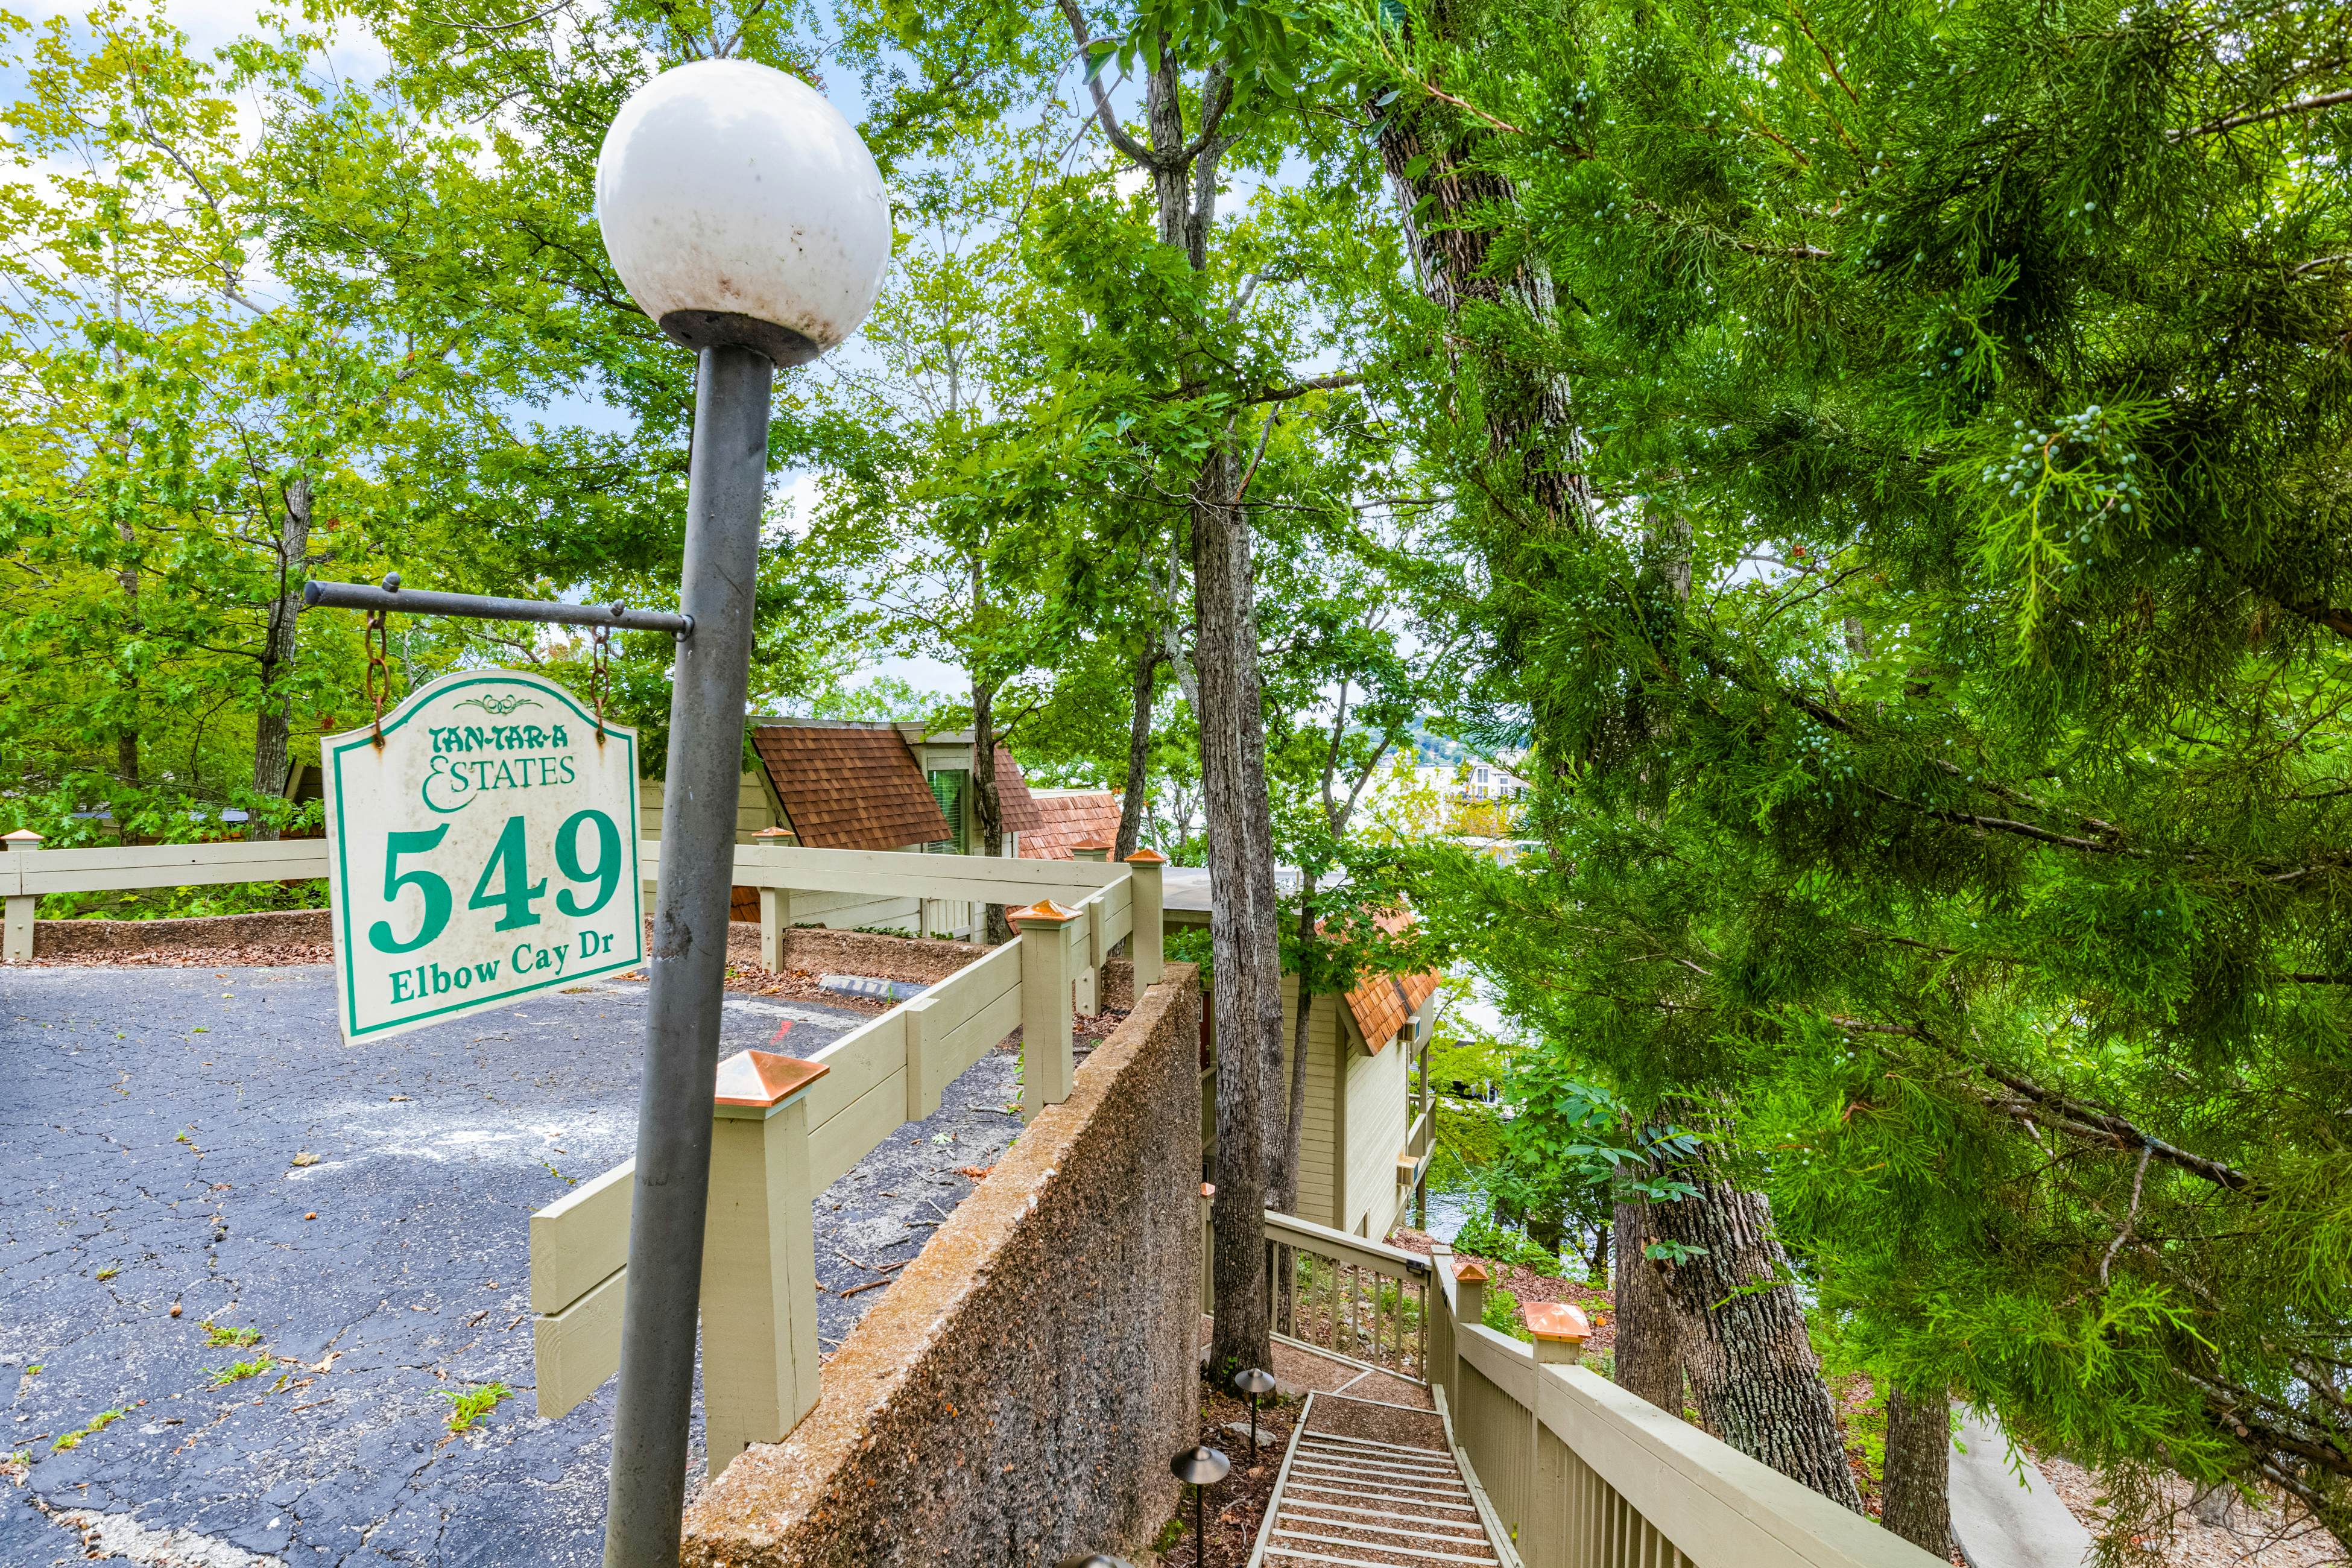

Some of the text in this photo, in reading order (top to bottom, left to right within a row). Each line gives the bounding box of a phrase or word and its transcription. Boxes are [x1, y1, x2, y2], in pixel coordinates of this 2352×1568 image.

[428, 724, 569, 753] TAN-TAR-A
[368, 809, 622, 955] 549
[389, 930, 614, 1004] Elbow Cay Dr
